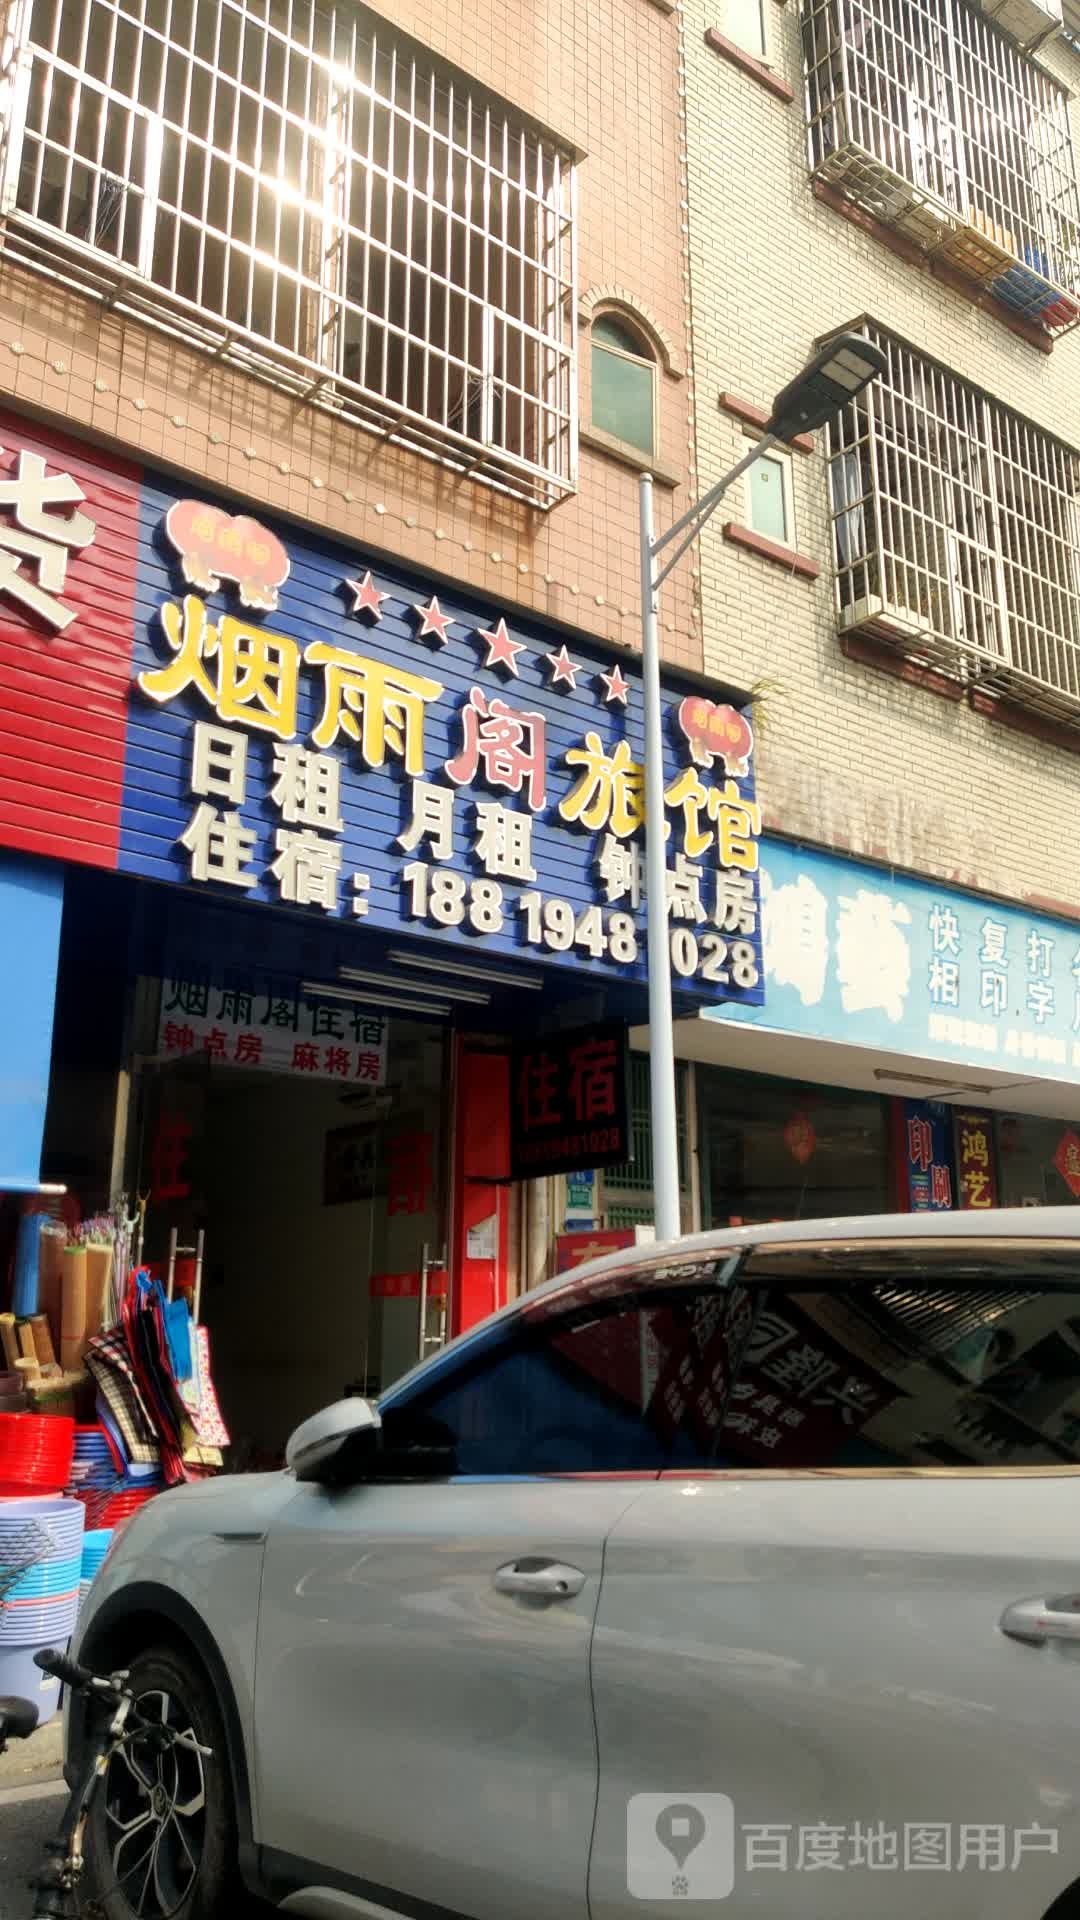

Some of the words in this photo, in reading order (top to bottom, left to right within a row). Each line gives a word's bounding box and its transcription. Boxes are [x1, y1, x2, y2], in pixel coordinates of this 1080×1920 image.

[137, 595, 761, 872] 烟雨阁旅馆
[190, 720, 345, 834] 日租
[397, 780, 537, 886] 月租
[599, 832, 756, 935] 钟点房
[402, 863, 504, 935] 188
[520, 893, 639, 963] 1948
[671, 927, 759, 988] 028
[929, 903, 961, 1008] 快相
[979, 916, 1009, 1017] 复印
[165, 979, 386, 1046] 烟雨阁住宿
[1027, 930, 1055, 1024] 打字
[163, 1021, 263, 1065] 钟点房
[291, 1041, 381, 1080] 麻将房
[519, 1036, 618, 1133] 住宿
[961, 1130, 992, 1207] 鸿艺
